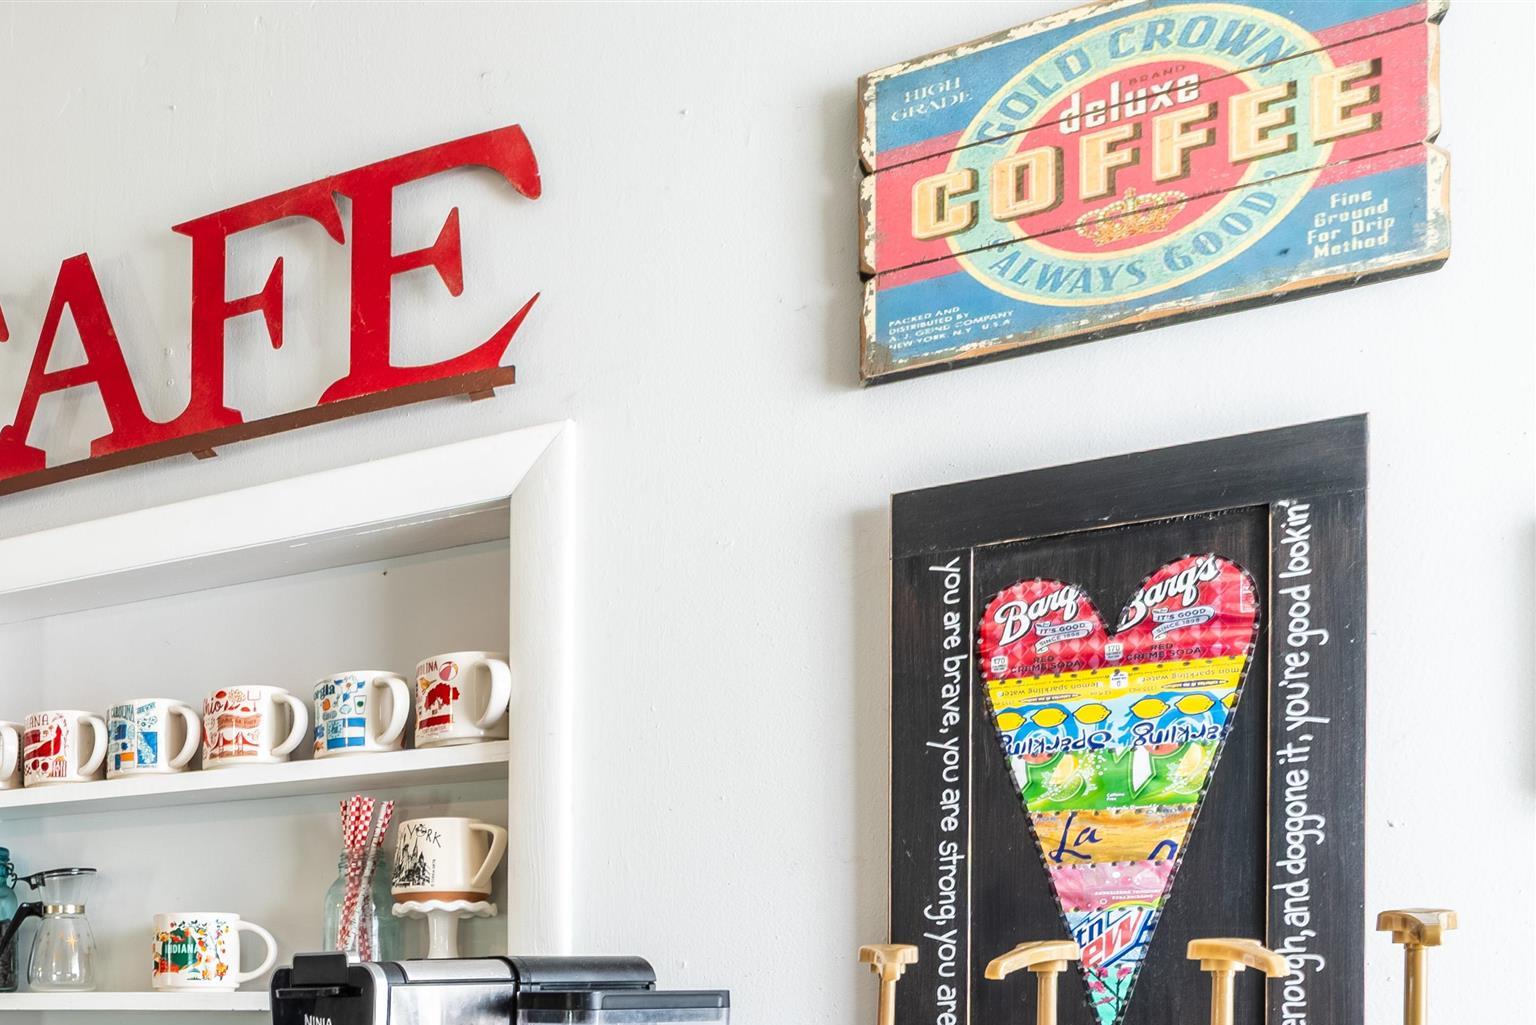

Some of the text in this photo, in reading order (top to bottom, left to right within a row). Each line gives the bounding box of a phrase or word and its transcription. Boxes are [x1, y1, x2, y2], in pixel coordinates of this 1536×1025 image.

[904, 77, 961, 103] HIGH
[976, 15, 1298, 145] GOLD CROWN
[891, 91, 974, 122] GRADE
[1058, 73, 1201, 135] deluxe
[912, 58, 1382, 242] COFFEE
[1314, 198, 1389, 228] Ground
[1330, 190, 1373, 209] Fine
[1307, 217, 1396, 246] For Drip
[1313, 231, 1389, 259] Method
[888, 306, 960, 328] PACKED AND
[954, 310, 1014, 328] COMPANY
[928, 558, 962, 605] you
[1116, 553, 1221, 633] Barq's
[942, 611, 962, 649] are
[1059, 622, 1086, 632] GOOD
[1178, 608, 1206, 618] GOOD
[1278, 583, 1329, 647] good
[939, 655, 966, 734] brave,
[1277, 651, 1331, 730] you're
[1132, 721, 1222, 748] arkling
[1279, 735, 1315, 764] it,
[925, 738, 962, 782] you
[939, 788, 962, 832] are
[1276, 769, 1327, 876] doggone
[1048, 812, 1104, 863] La
[923, 840, 965, 926] strong,
[1272, 877, 1310, 927] and
[923, 930, 959, 981] you
